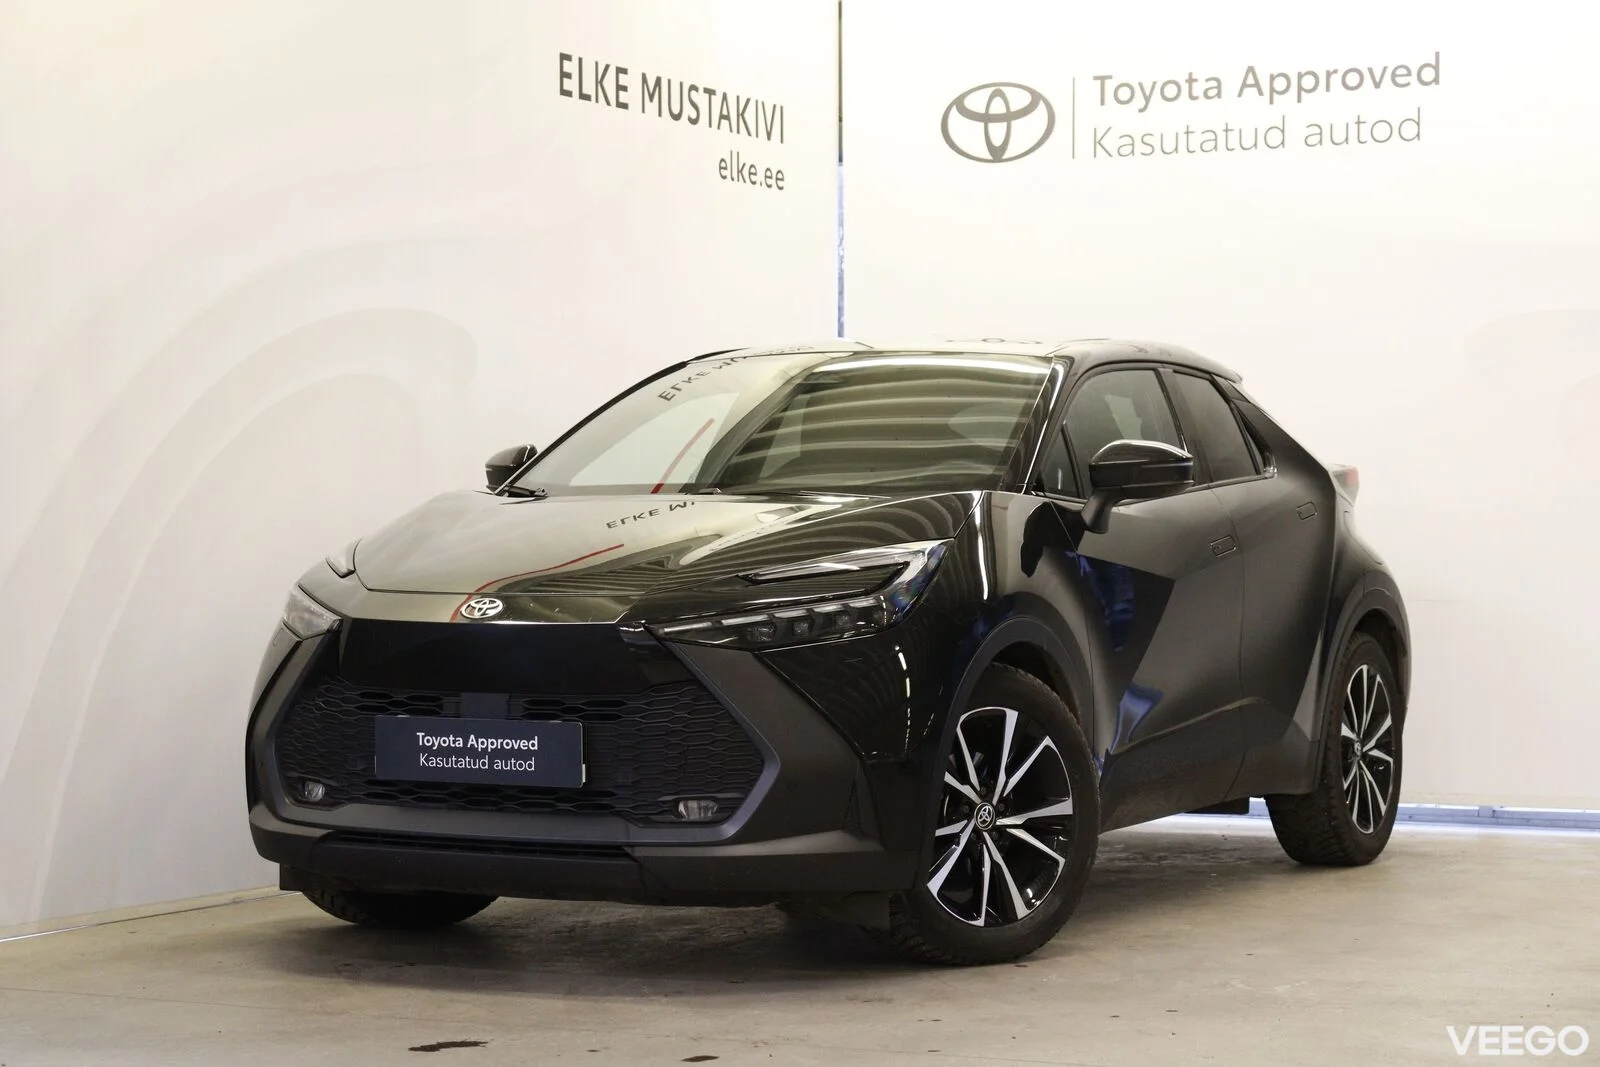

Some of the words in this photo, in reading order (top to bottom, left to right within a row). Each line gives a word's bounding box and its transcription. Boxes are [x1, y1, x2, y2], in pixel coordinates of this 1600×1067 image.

[559, 52, 629, 110] ELKE
[641, 72, 784, 144] MUSTAKIVI
[1093, 72, 1223, 113] Toyota
[1237, 51, 1441, 104] Approved
[1093, 115, 1286, 158] Kasutatud
[1303, 107, 1421, 148] autod
[719, 150, 785, 191] elke.ee
[416, 732, 463, 750] Toyota
[467, 734, 538, 752] Approved
[419, 753, 489, 770] Kasutatud
[493, 756, 535, 771] autod
